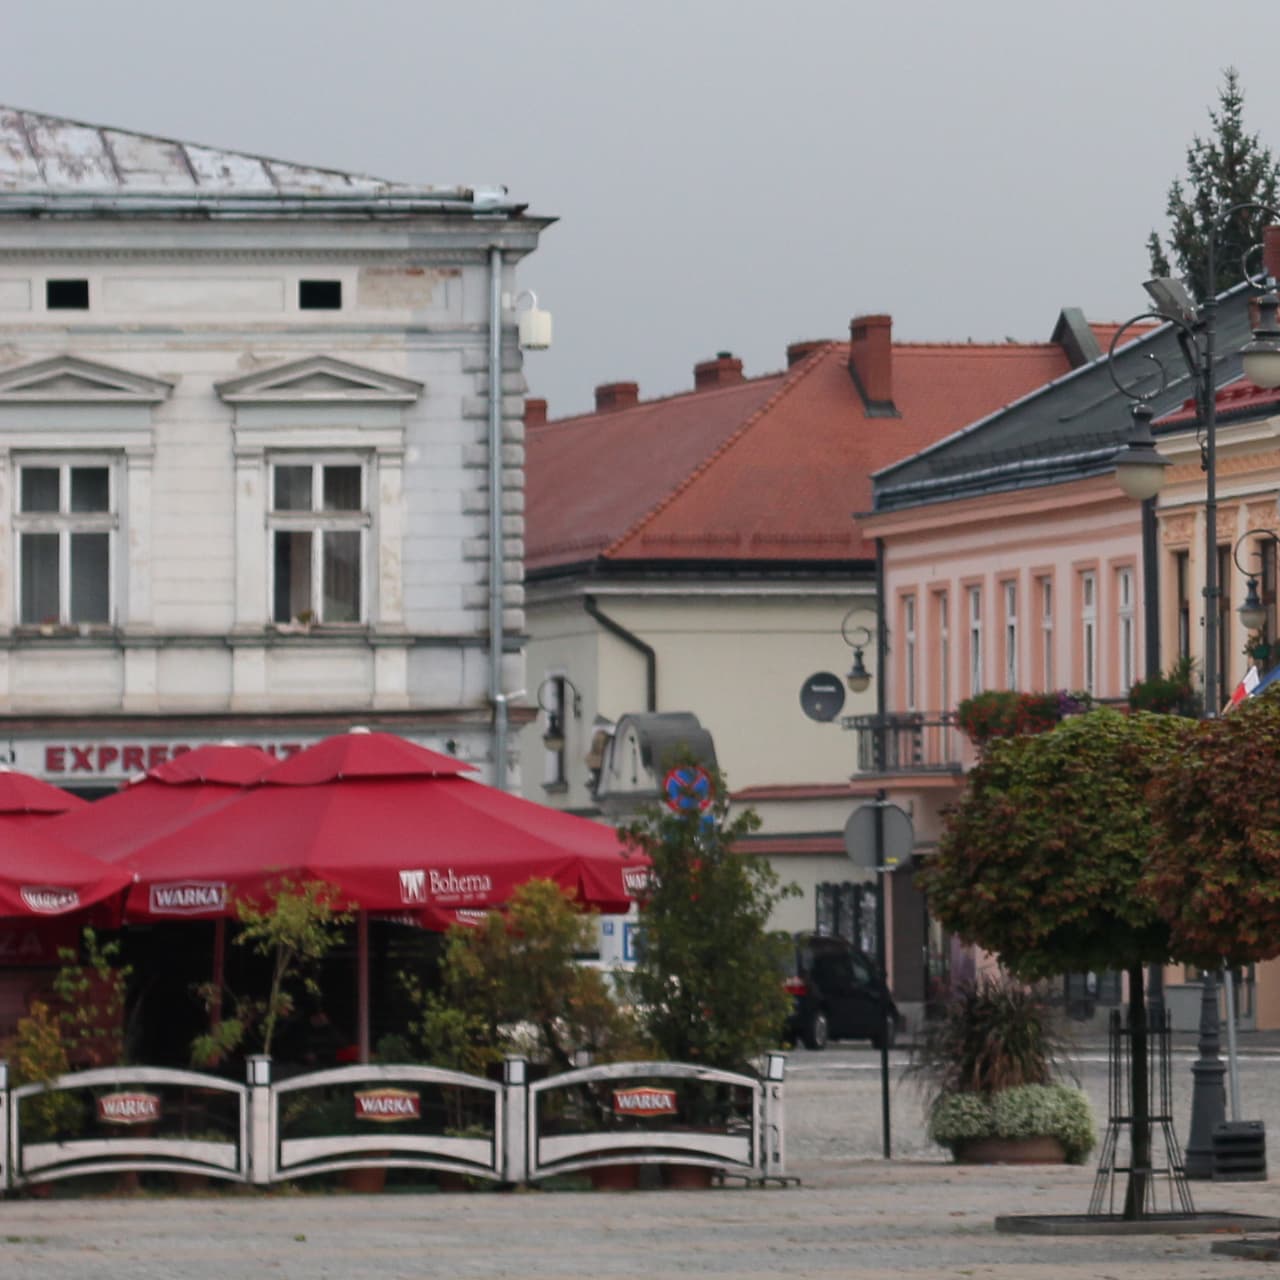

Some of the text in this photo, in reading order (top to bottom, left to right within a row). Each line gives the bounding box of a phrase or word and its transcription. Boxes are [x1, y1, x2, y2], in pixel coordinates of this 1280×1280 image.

[429, 868, 492, 893] Bohema
[155, 886, 220, 907] WARKA
[101, 1098, 156, 1117] WARKA
[358, 1092, 416, 1114] WARKA
[616, 1091, 673, 1110] WARKA
